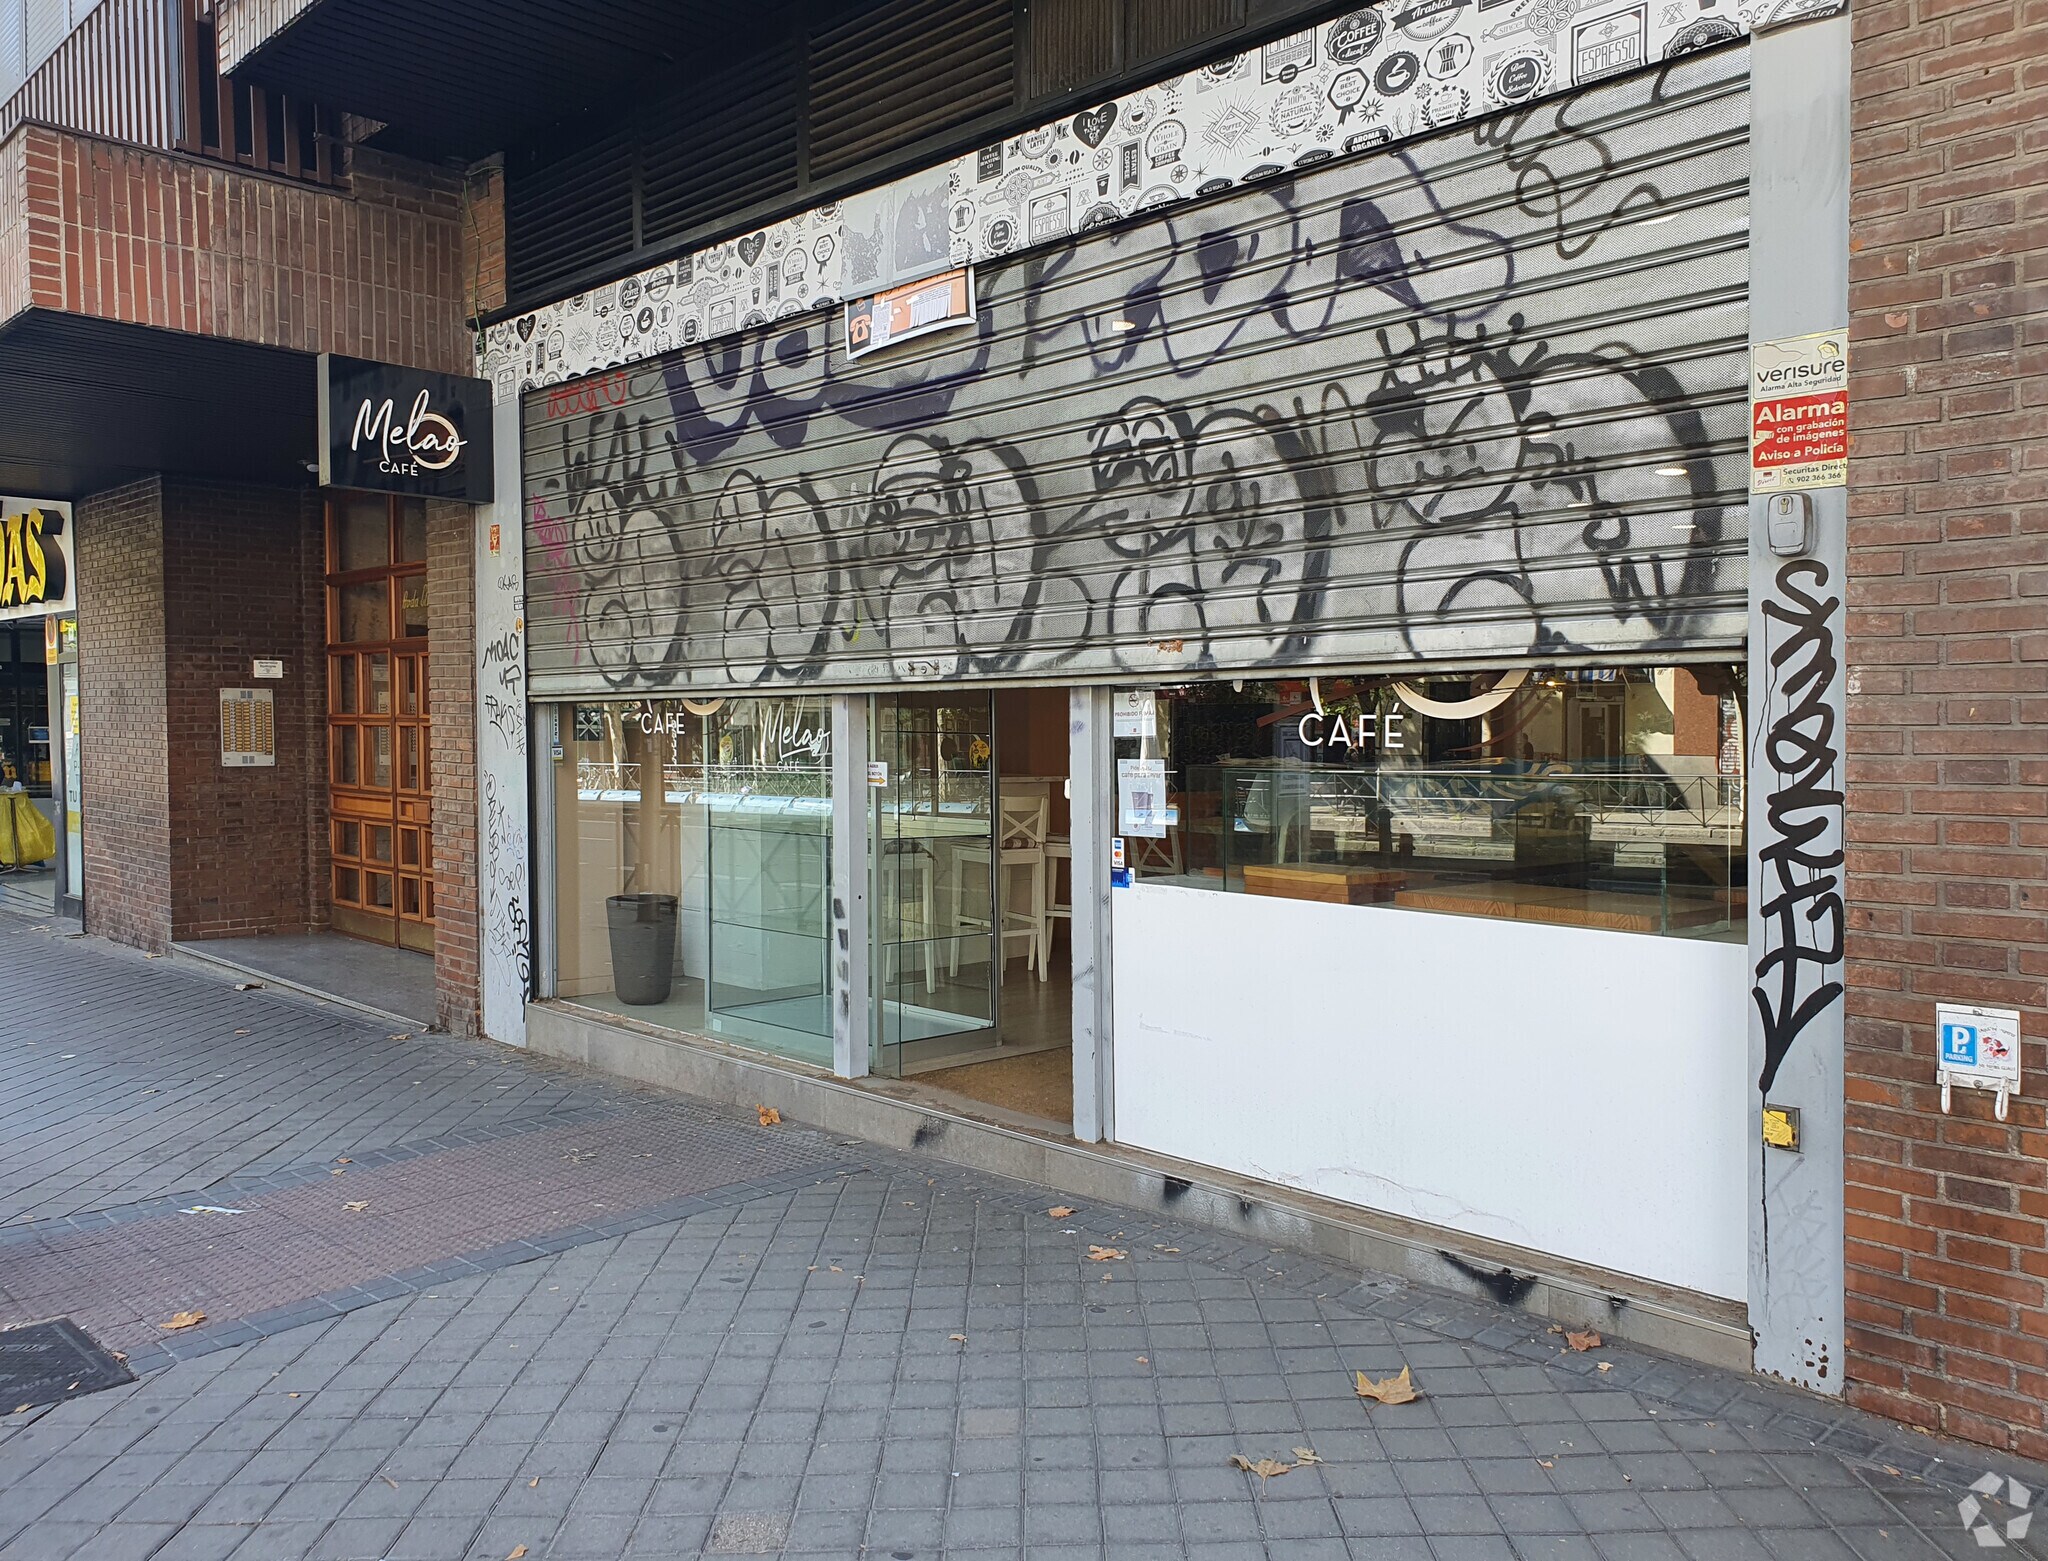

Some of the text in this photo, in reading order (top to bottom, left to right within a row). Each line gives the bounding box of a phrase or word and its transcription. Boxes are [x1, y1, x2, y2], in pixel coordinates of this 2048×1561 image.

[1336, 22, 1378, 48] COFFEE
[1581, 36, 1636, 74] ESPRESSO
[1340, 80, 1357, 90] BEST
[1508, 71, 1528, 84] Coffee
[1335, 86, 1361, 99] CHOICE
[1280, 104, 1313, 120] NATURAL
[1431, 101, 1460, 114] PREMIUM
[1026, 131, 1050, 145] VANILLA
[1029, 138, 1046, 149] LATTE
[1351, 137, 1384, 152] ORGANIC
[1352, 130, 1380, 145] AROMA
[1315, 152, 1330, 162] ROAST
[1021, 164, 1045, 174] QUALITY
[1263, 167, 1278, 177] ROAST
[1757, 359, 1845, 383] verisure
[1760, 374, 1842, 393] Alarma Alta Seguridad
[1755, 400, 1846, 425] Alarma
[351, 388, 469, 462] Melao
[1776, 418, 1845, 434] con grabación
[1776, 428, 1845, 444] de imágenes
[1757, 442, 1844, 462] Aviso a Policía
[379, 460, 419, 477] CAFÉ
[1782, 461, 1848, 476] Securitas Direct
[1796, 472, 1842, 484] 902 366 366
[0, 506, 47, 608] AS
[640, 704, 686, 735] CAFÉ
[1298, 703, 1405, 749] CAFÉ
[1951, 1026, 1970, 1054] P
[1944, 1052, 1973, 1063] PARKING
